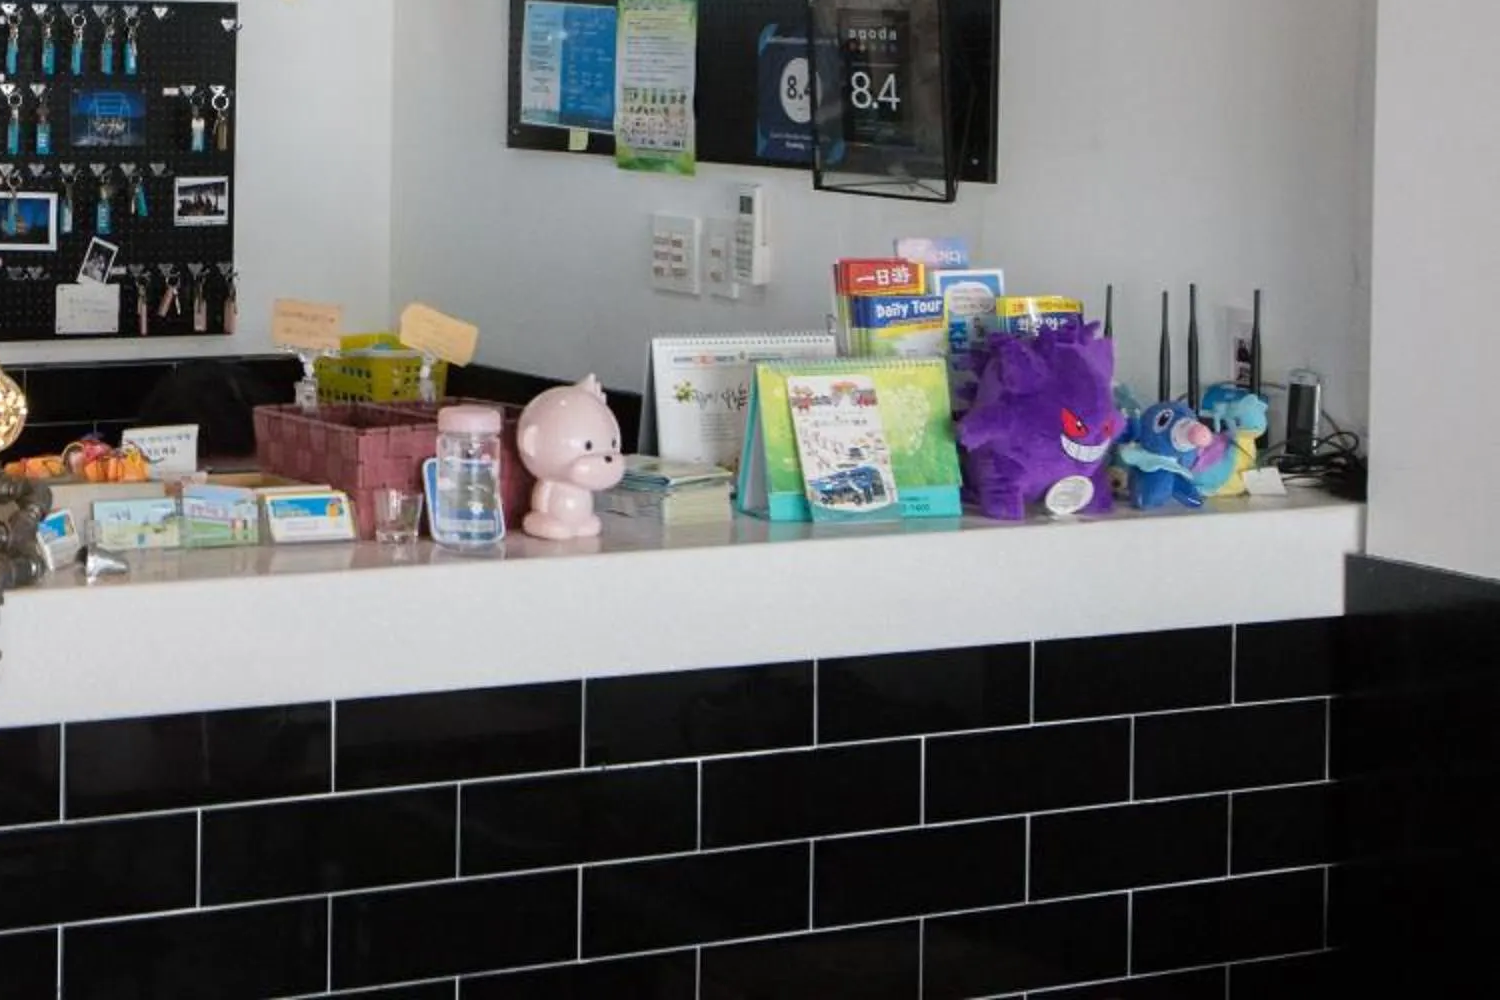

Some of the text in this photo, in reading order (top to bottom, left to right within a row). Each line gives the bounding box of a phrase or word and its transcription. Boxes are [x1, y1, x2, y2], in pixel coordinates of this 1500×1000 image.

[850, 70, 901, 112] 8.4
[875, 299, 943, 319] Daily Tour
